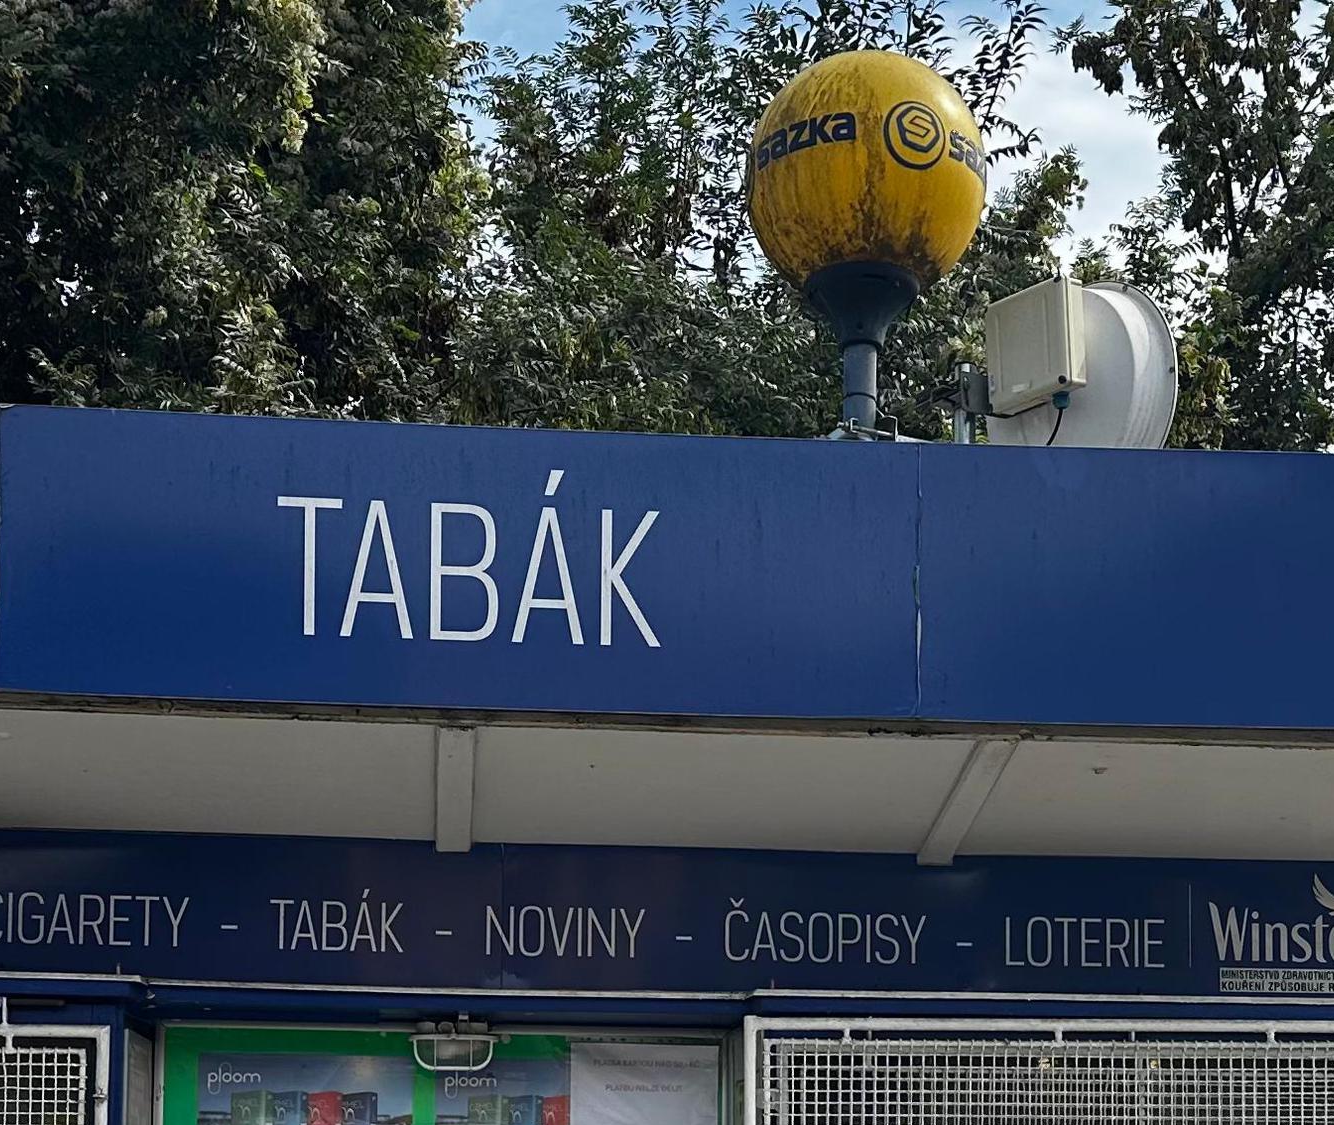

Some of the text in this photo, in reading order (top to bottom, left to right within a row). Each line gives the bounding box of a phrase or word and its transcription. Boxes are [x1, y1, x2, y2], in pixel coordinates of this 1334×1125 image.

[277, 470, 661, 647] TABÁK
[270, 888, 404, 953] TABÁK
[484, 904, 646, 959] NOVINY
[723, 898, 927, 965] ČASOPISY
[1004, 916, 1166, 968] LOTERIE
[1221, 970, 1279, 980] MINISTERSTVO
[1221, 980, 1265, 991] KOUŘENÍ
[1268, 980, 1325, 992] ZPŮSOBUJE
[207, 1062, 261, 1095] ploom
[444, 1072, 497, 1099] ploom
